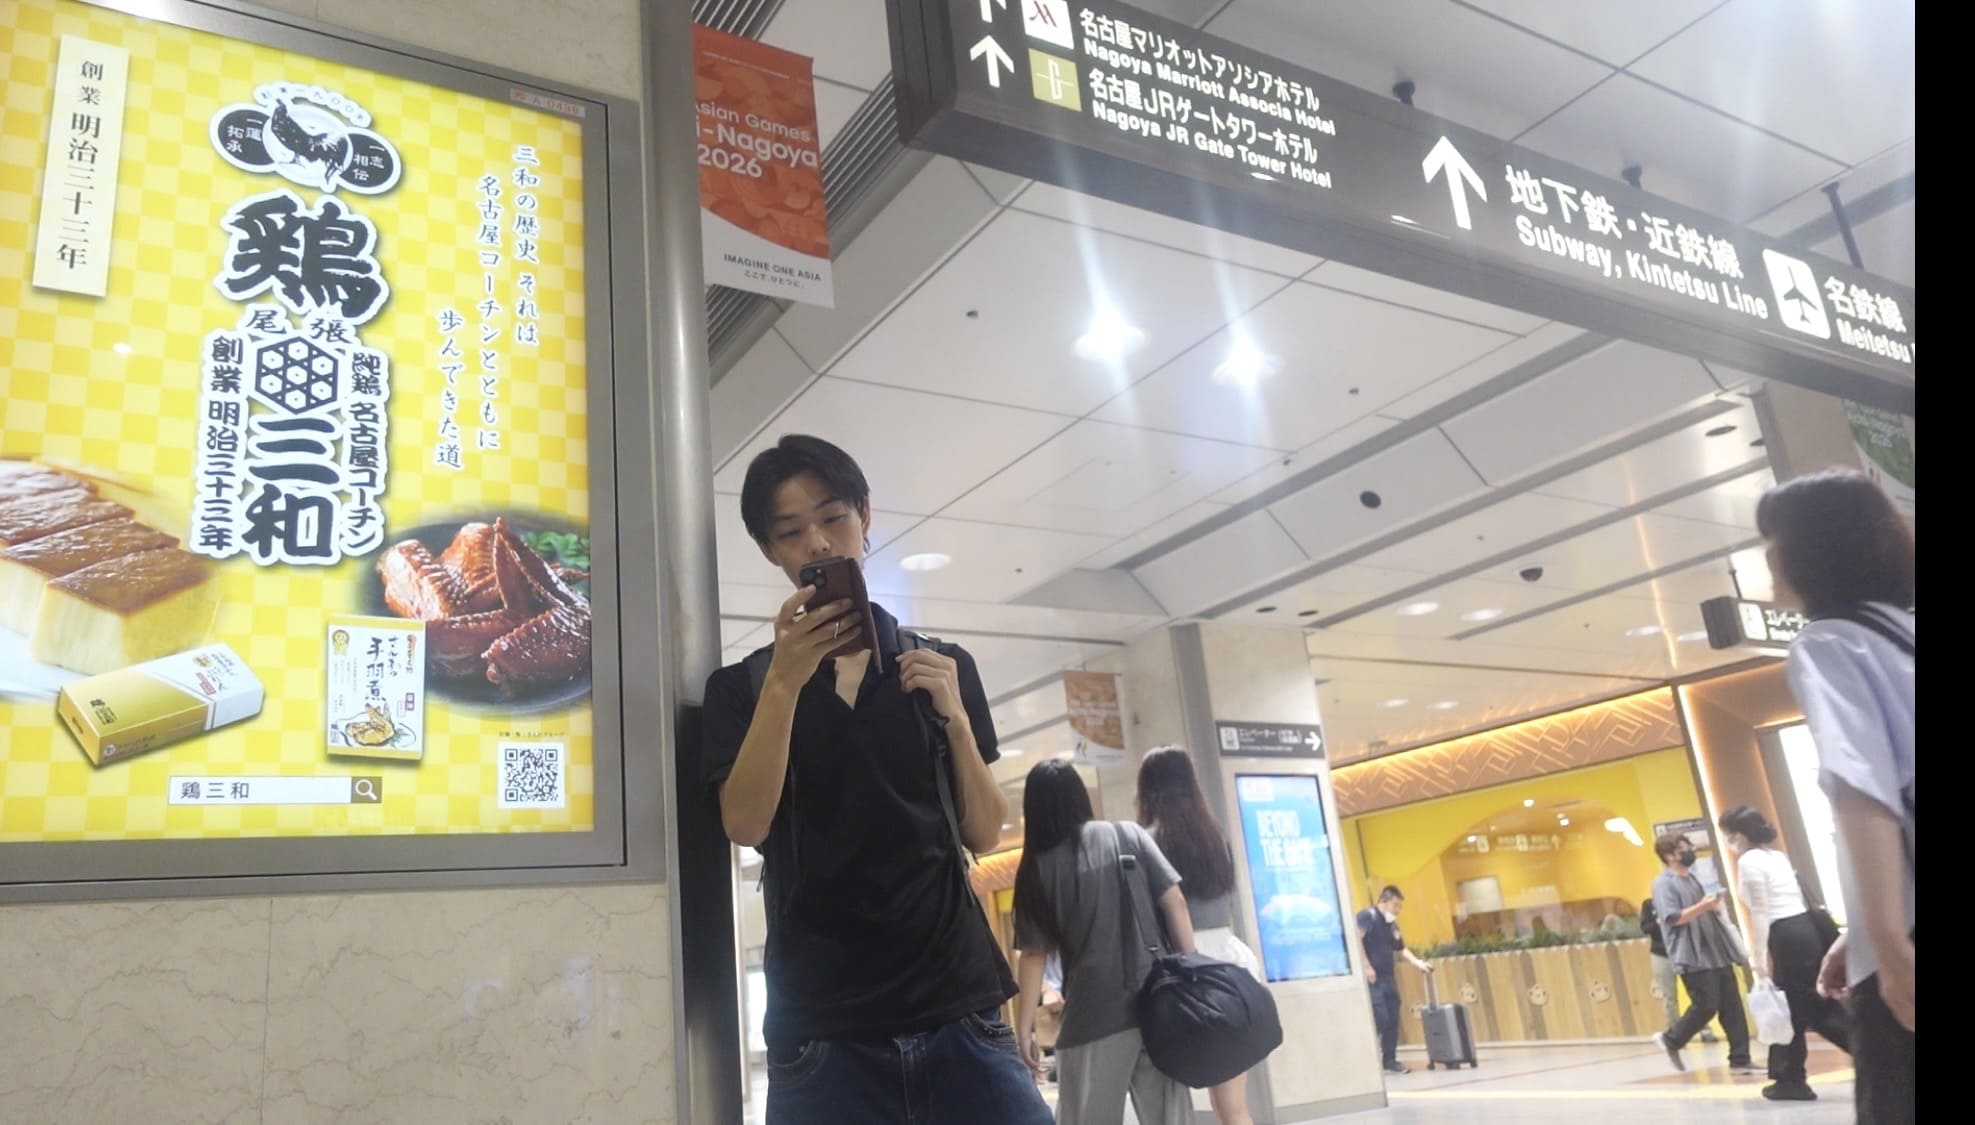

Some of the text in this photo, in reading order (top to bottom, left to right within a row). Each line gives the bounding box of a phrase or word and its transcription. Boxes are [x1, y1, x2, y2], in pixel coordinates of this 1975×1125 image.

[1080, 8, 1320, 112] 名古屋マリオットアソシアホテル
[1084, 38, 1336, 136] Nagoya Marriott Associa Hotel
[697, 144, 763, 179] 2026
[745, 112, 811, 142] Games
[1089, 68, 1318, 164] 名古屋JRゲートタワーホテル
[1093, 99, 1332, 188] Nagoya JR Gate Tower Hotel
[225, 194, 382, 320] 鶏
[514, 146, 539, 345] 三和の歴史 それは
[724, 253, 822, 281] IMAGINE ONE ASIA
[1505, 164, 1744, 279] 地下鉄・近鉄線
[1515, 214, 1769, 320] Subway, Kintetsu Line
[246, 309, 352, 344] 尾張
[478, 176, 502, 449] 名古屋コーチンとともに
[1824, 276, 1907, 333] 名鉄線
[1836, 318, 1912, 364] Meitetsu
[436, 310, 464, 470] 歩んできた道
[241, 417, 340, 558] 三和
[365, 636, 386, 702] 手羽煮
[181, 781, 249, 800] 鶏三和
